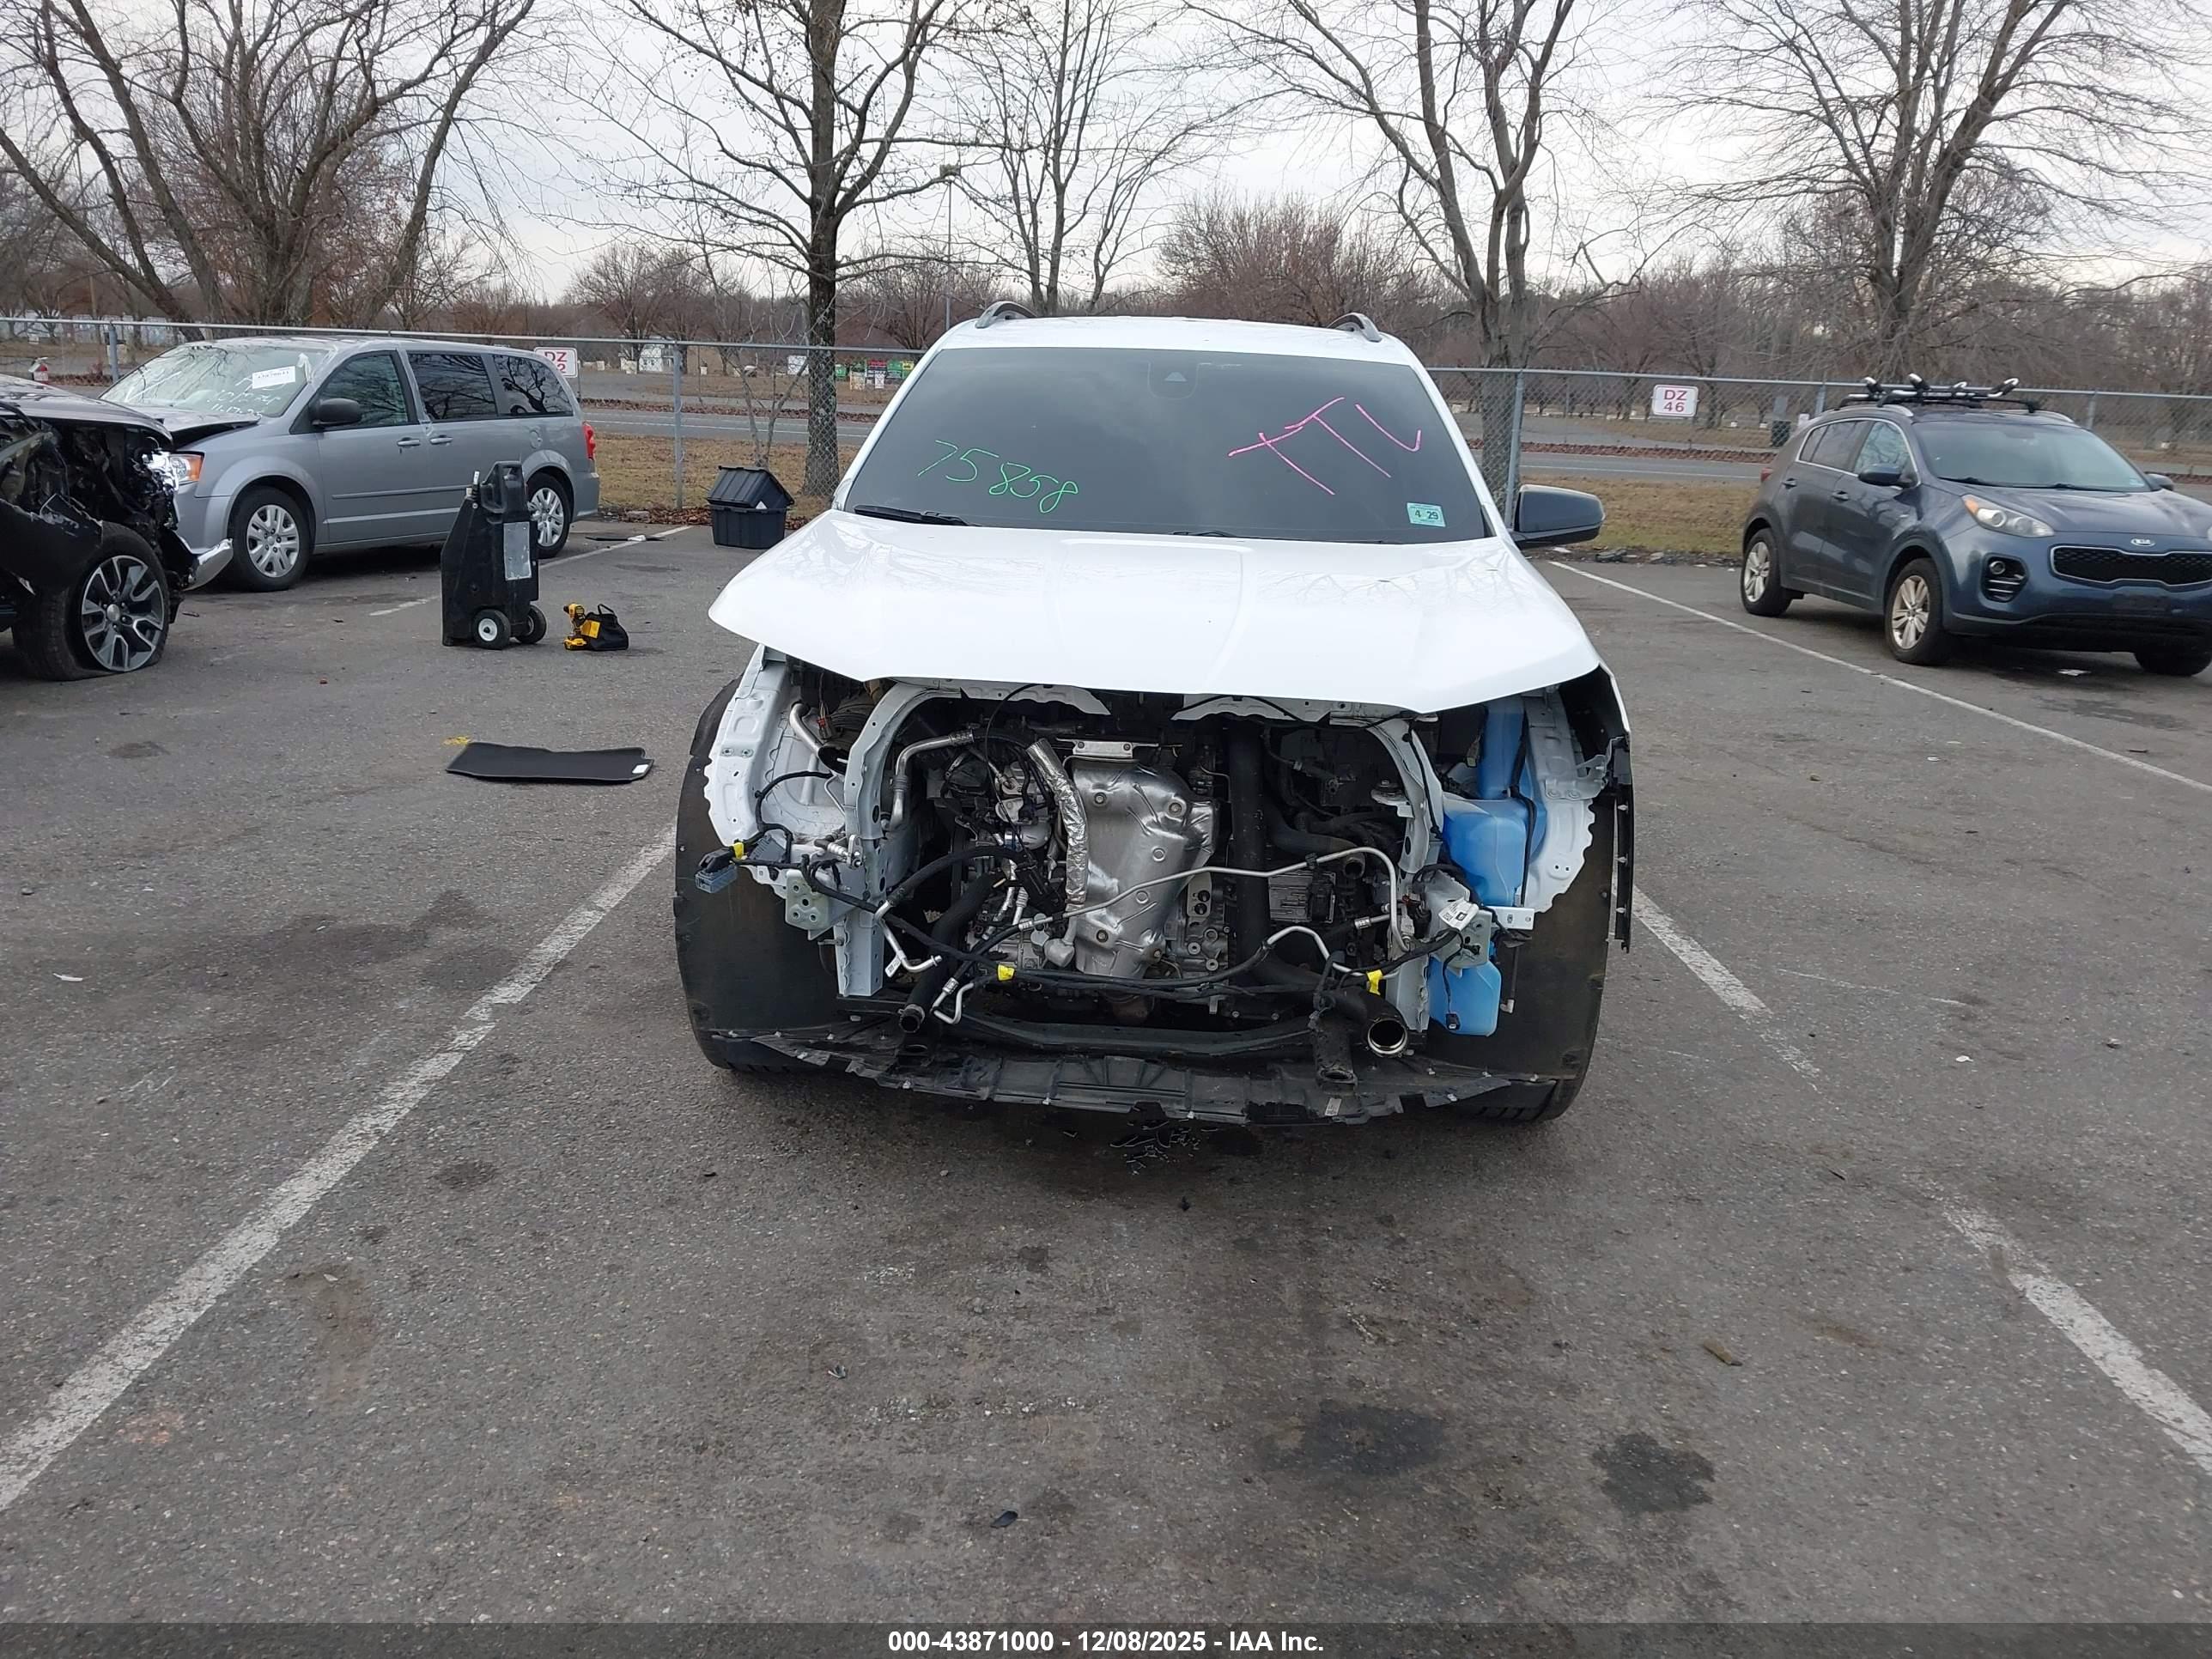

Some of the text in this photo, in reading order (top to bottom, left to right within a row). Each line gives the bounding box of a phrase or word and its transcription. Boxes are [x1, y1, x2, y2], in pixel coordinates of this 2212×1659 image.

[1664, 390, 1687, 401] DZ
[1663, 402, 1685, 412] 46
[917, 440, 1079, 514] 75858
[1414, 509, 1438, 520] 4 29
